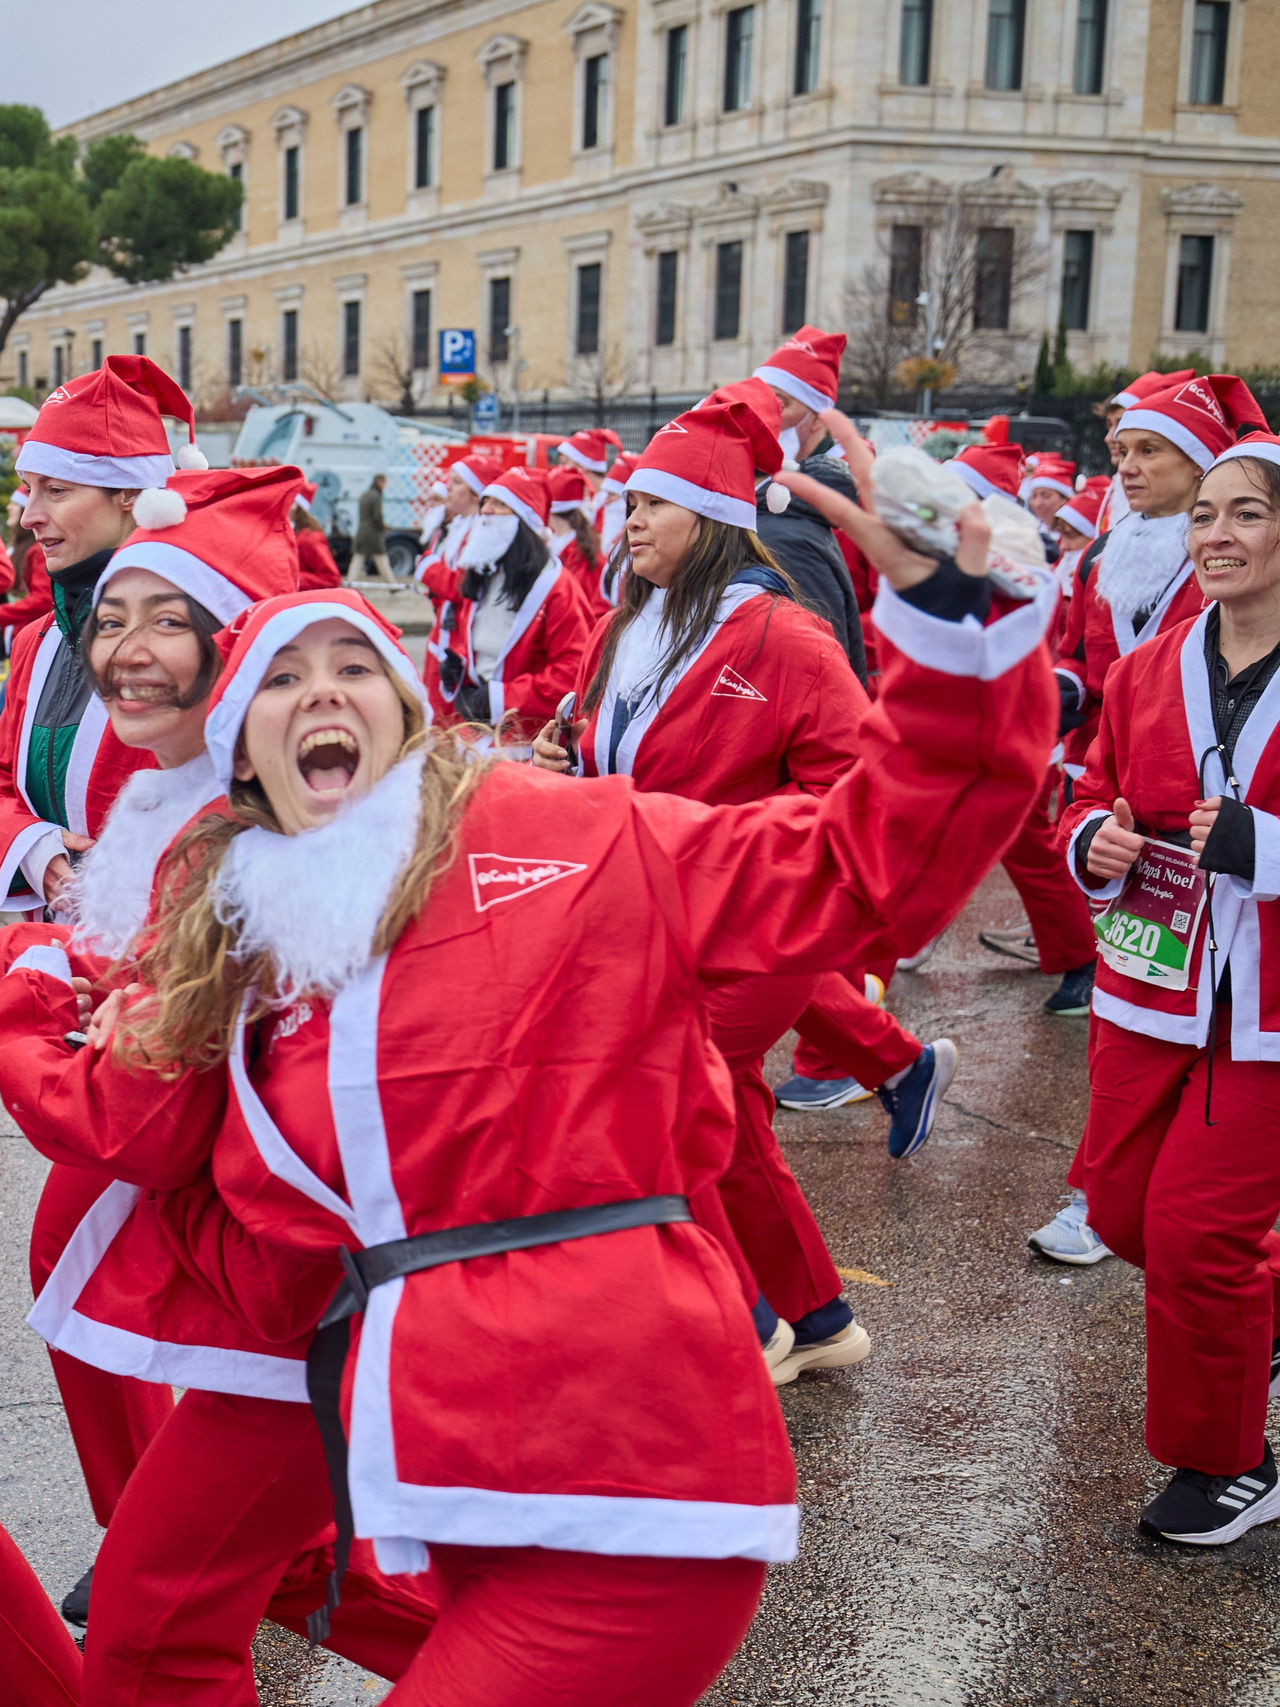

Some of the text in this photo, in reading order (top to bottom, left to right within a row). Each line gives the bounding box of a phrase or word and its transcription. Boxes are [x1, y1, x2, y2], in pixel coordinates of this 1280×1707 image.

[443, 330, 465, 363] P
[1162, 867, 1196, 890] Noel
[1103, 912, 1161, 958] 3620
